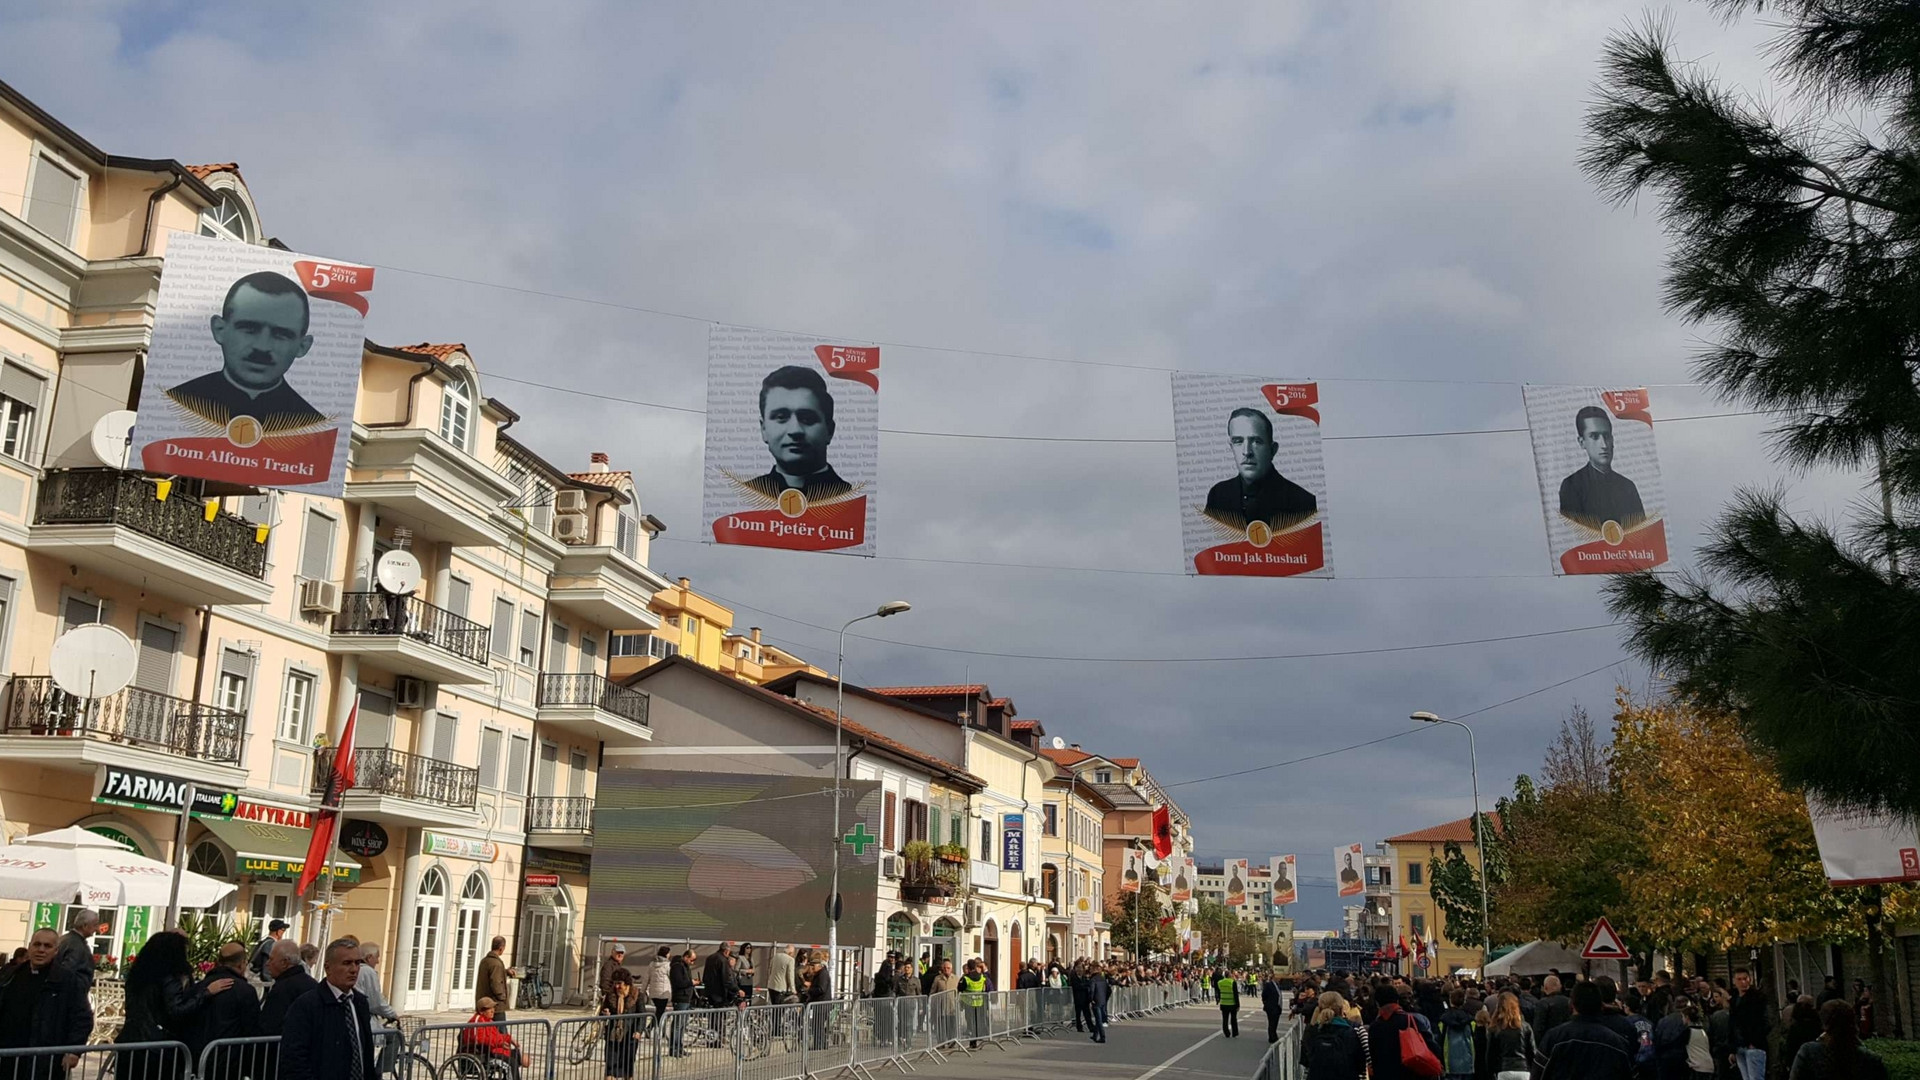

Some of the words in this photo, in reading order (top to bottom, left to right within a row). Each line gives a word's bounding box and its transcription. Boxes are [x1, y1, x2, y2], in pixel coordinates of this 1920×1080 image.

[312, 264, 332, 288] 5
[331, 272, 356, 284] 2016
[831, 347, 846, 369] 5
[846, 354, 867, 363] 2016
[1276, 386, 1289, 406] 5
[1288, 391, 1307, 399] 2016
[1614, 393, 1626, 412] 5
[165, 443, 203, 460] Dom
[206, 449, 258, 467] Alfons
[263, 457, 315, 476] Tracki
[728, 516, 765, 531] Dom
[769, 520, 815, 536] Pjetër
[818, 525, 854, 540] Çuni
[1215, 552, 1241, 562] Dom
[1243, 552, 1263, 565] Jak
[1265, 553, 1308, 564] Bushati
[1577, 551, 1602, 561] Dom
[1603, 550, 1627, 560] Dedë
[1629, 549, 1655, 562] Malaj
[351, 836, 366, 847] WINE
[367, 838, 383, 849] SHOP
[1007, 831, 1022, 868] MARKET
[1904, 852, 1916, 868] 5
[246, 860, 279, 871] LULE
[287, 863, 350, 877] NARLE
[88, 889, 111, 901] Spring
